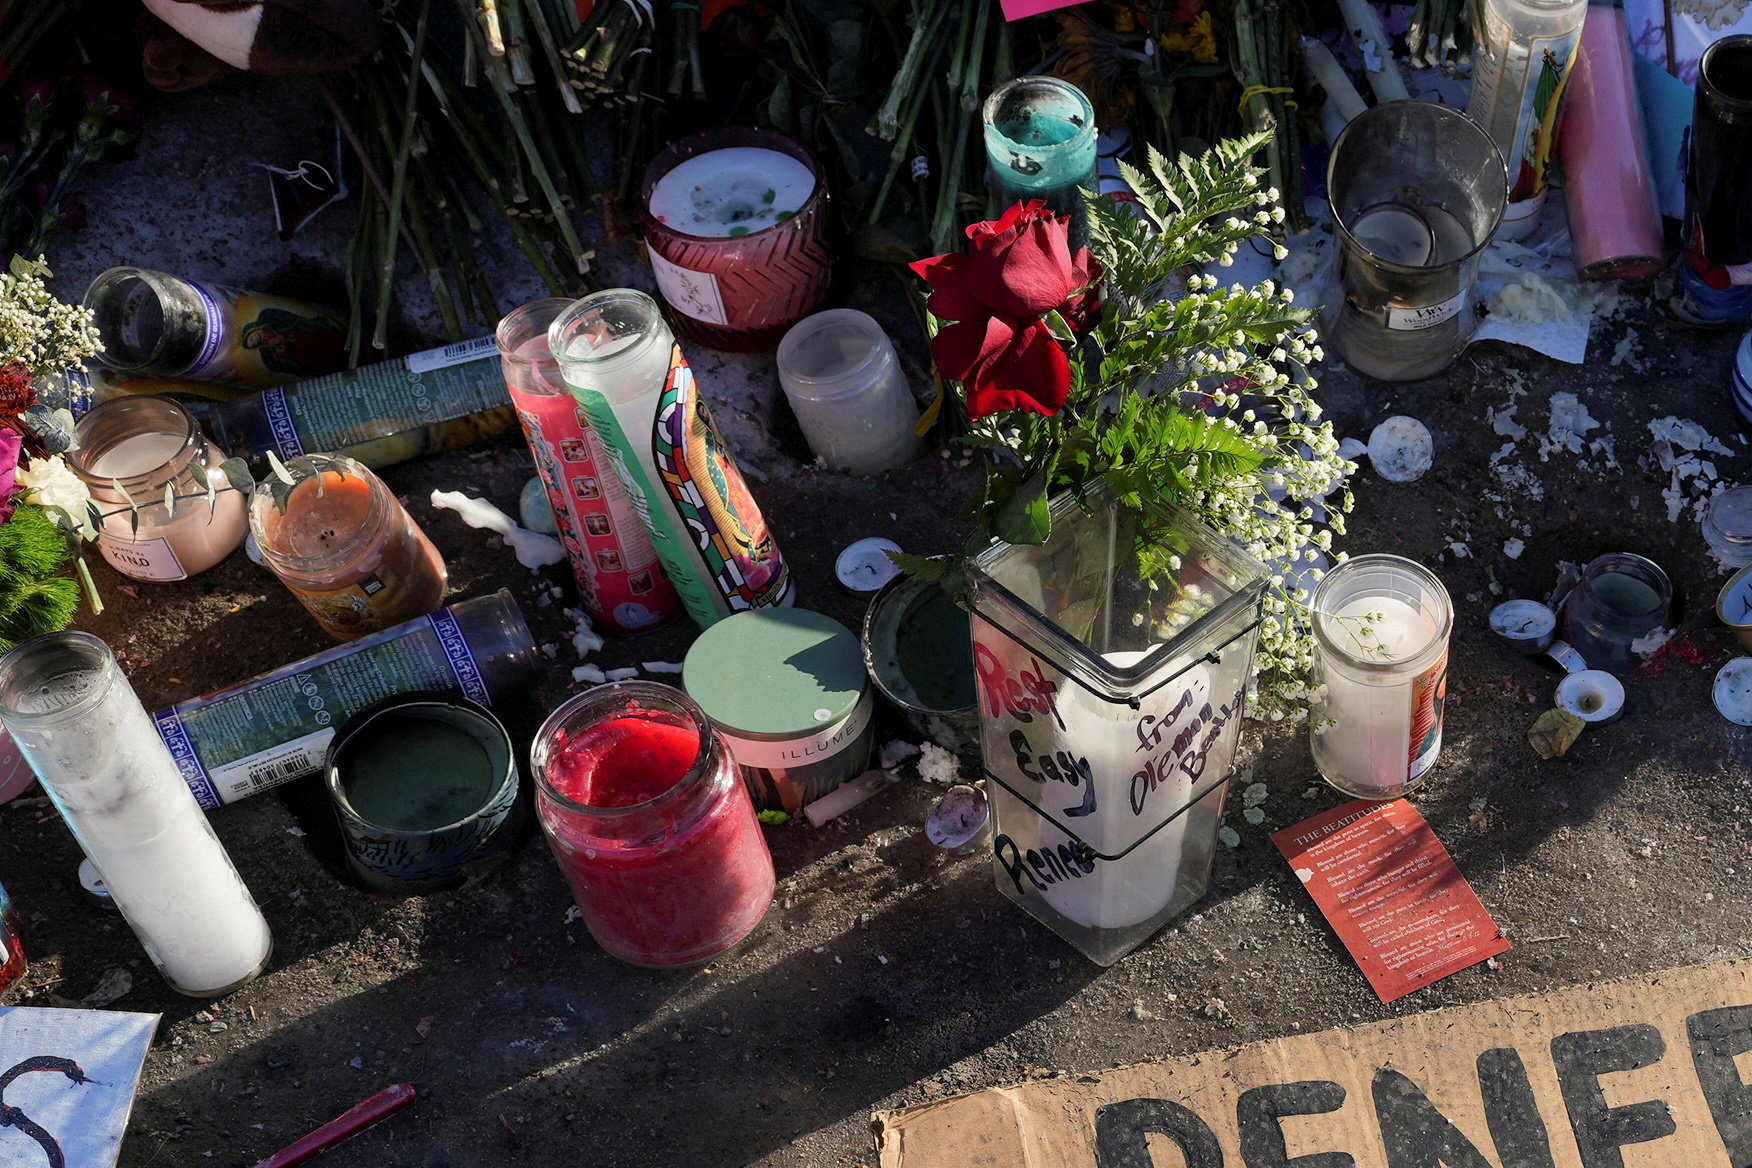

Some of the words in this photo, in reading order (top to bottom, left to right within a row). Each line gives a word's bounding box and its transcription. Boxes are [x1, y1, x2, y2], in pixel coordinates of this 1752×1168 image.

[111, 550, 151, 568] KIND
[975, 641, 1067, 732] Rest
[1136, 688, 1194, 753] from
[1009, 729, 1097, 817] Easy
[1294, 829, 1323, 847] THE
[1322, 803, 1396, 835] BEATITUDES
